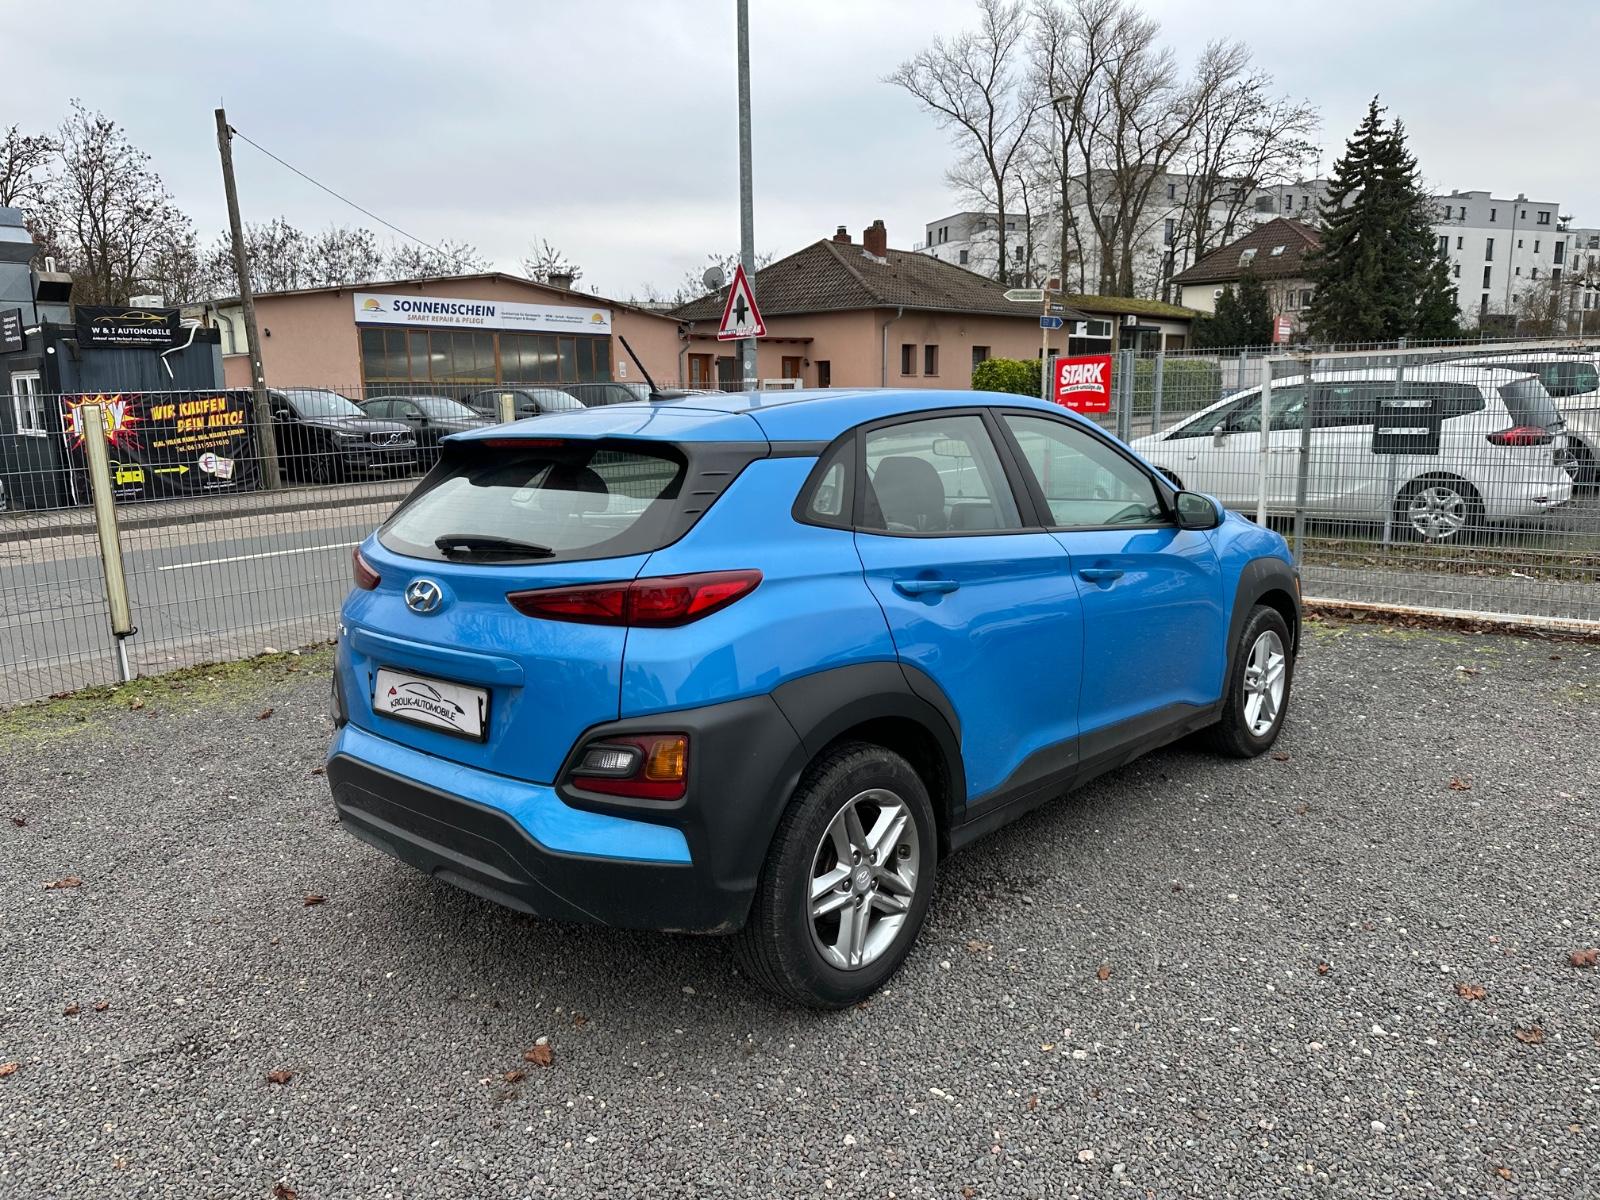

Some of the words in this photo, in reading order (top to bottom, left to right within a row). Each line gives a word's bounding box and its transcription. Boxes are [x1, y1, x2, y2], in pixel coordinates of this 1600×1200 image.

[393, 299, 496, 317] SONNENSCHEIN
[407, 314, 430, 322] SMART
[431, 315, 454, 323] REPAIR
[117, 327, 171, 336] AUTOMOBILE
[1060, 362, 1106, 385] STARK
[150, 404, 176, 421] WIR
[179, 398, 226, 417] KAUFEN
[177, 416, 205, 433] DEIN
[208, 410, 244, 428] AUTO!
